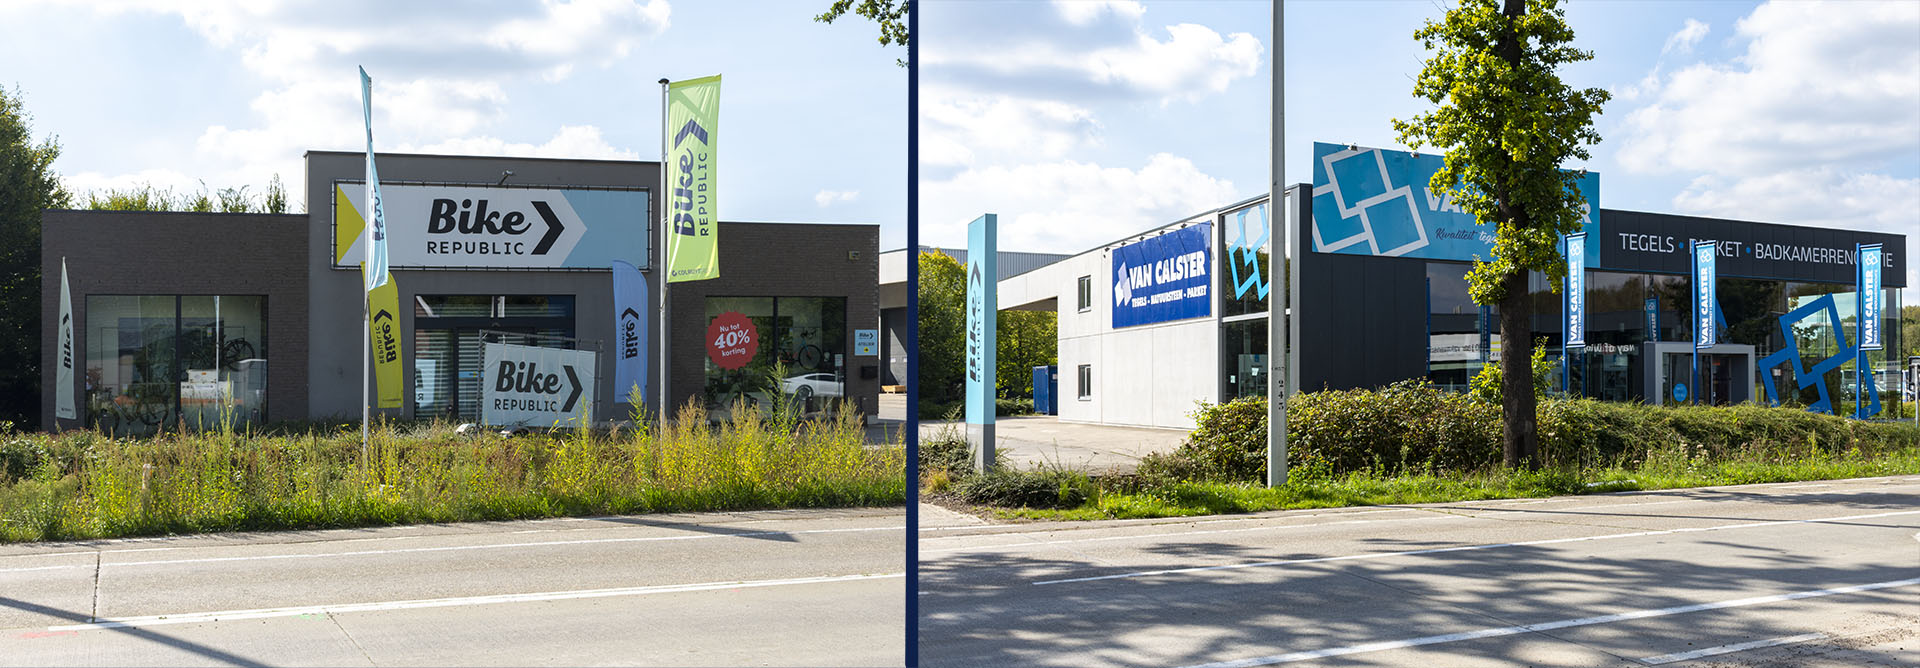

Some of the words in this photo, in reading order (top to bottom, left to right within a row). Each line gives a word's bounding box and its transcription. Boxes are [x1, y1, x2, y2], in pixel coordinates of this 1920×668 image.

[673, 147, 696, 237] Bike
[697, 152, 709, 236] REPUBLIC
[427, 198, 532, 235] Bike
[1435, 227, 1478, 241] Kwaliteit
[1619, 232, 1675, 254] TEGELS
[1689, 238, 1742, 258] PKET
[427, 241, 524, 255] REPUBLIC
[1129, 263, 1152, 290] VAN
[1155, 250, 1206, 285] CALSTER
[1131, 296, 1147, 308] TEGELS
[1150, 289, 1183, 305] NATUURSTEEN
[1187, 284, 1207, 298] PARKET
[1570, 261, 1578, 312] CALSTER
[1700, 267, 1708, 315] CALSTER
[1865, 270, 1873, 317] CALSTER
[714, 329, 750, 349] 40%
[719, 325, 729, 333] Nu
[1570, 314, 1578, 341] VAN
[1701, 318, 1709, 345] VAN
[1865, 320, 1873, 344] VAN
[63, 326, 72, 370] Bike
[721, 347, 746, 357] korting
[495, 360, 563, 396] Bike
[494, 398, 558, 413] REPUBLIC
